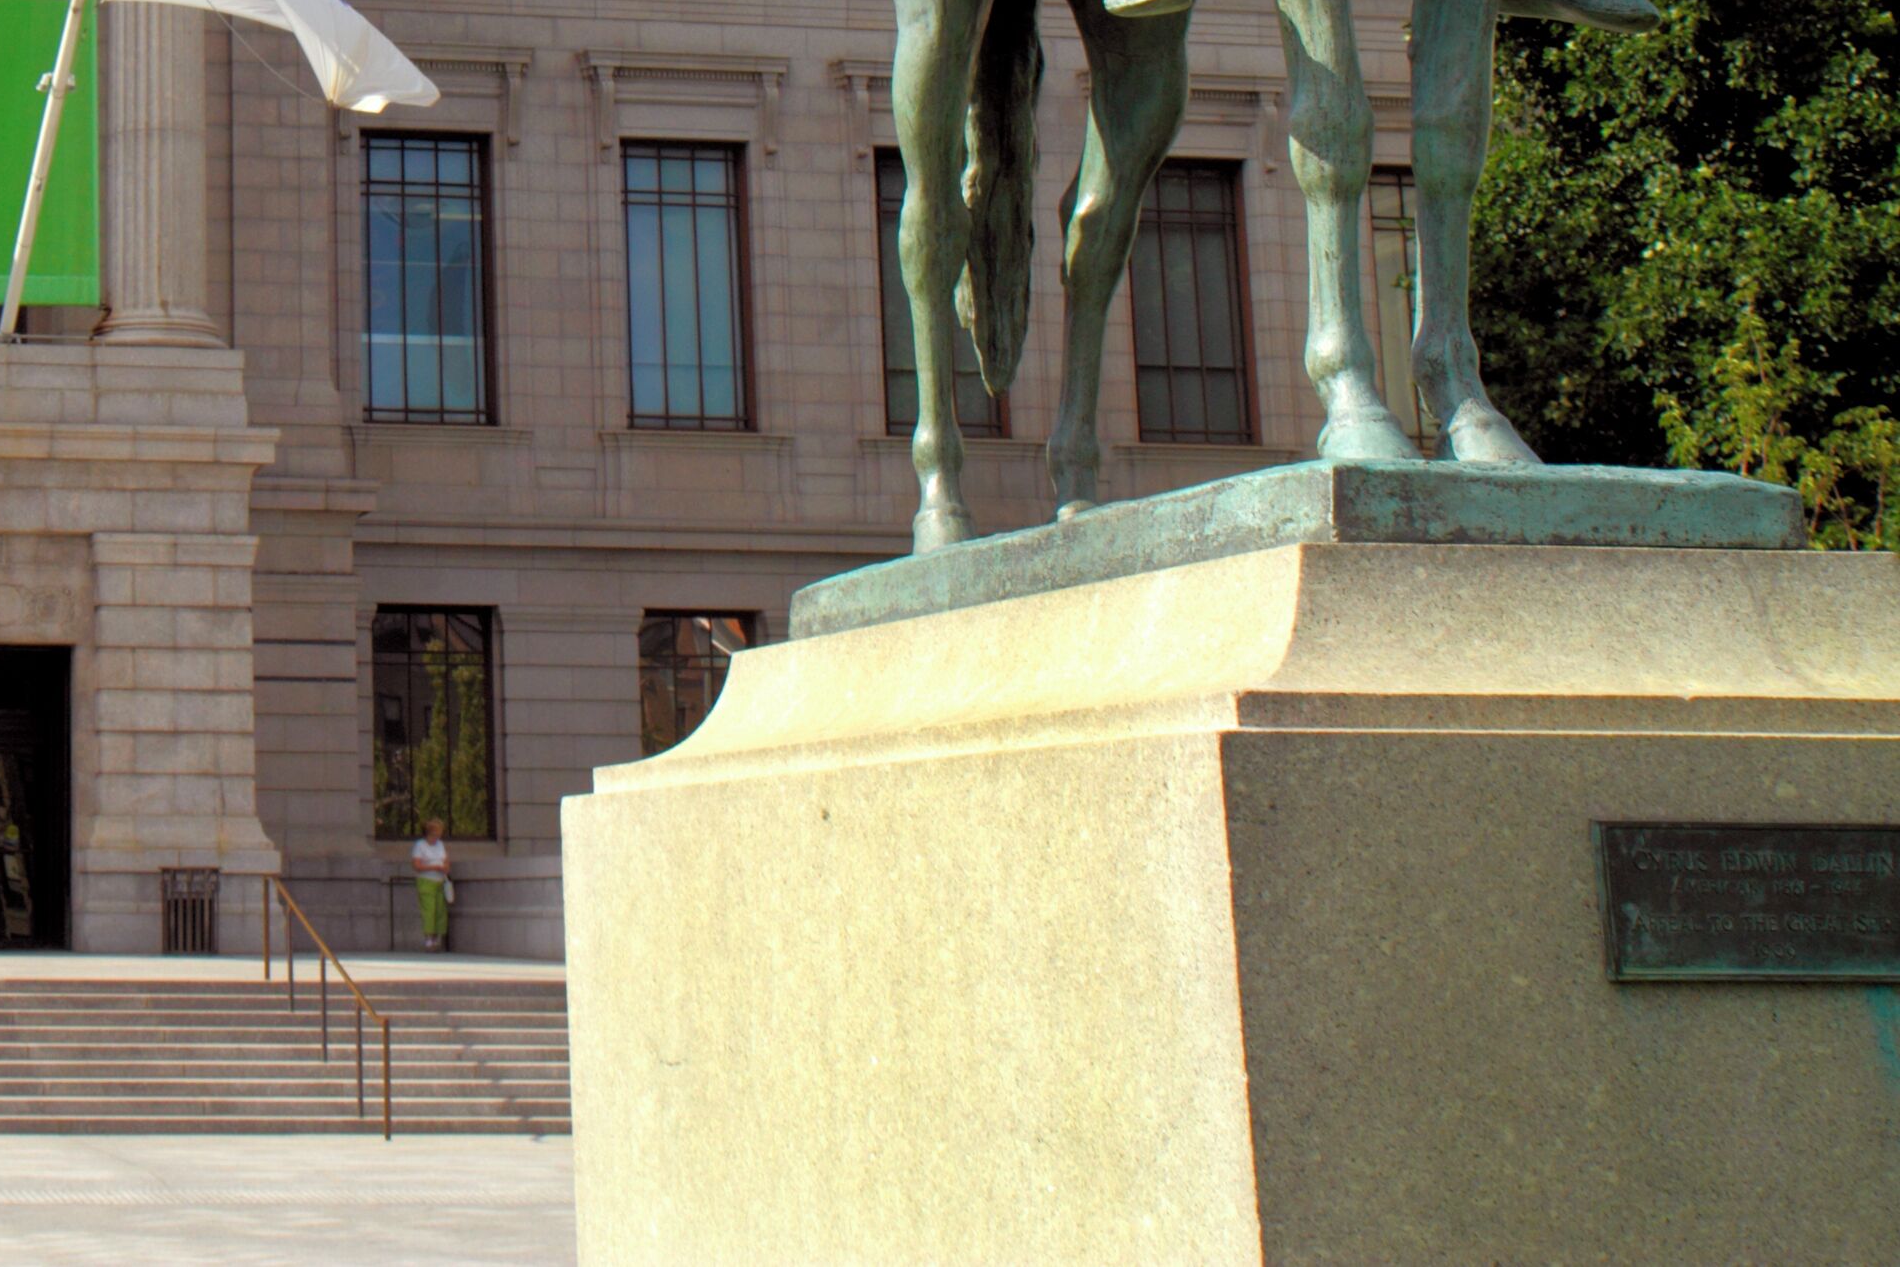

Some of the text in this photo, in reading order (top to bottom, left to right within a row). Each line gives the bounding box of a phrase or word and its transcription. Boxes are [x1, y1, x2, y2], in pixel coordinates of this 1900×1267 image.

[1633, 849, 1708, 872] CYRUS
[1720, 849, 1799, 872] EDWIN
[1708, 914, 1735, 934] TO
[1740, 914, 1778, 932] THE
[1784, 913, 1844, 933] GREAT
